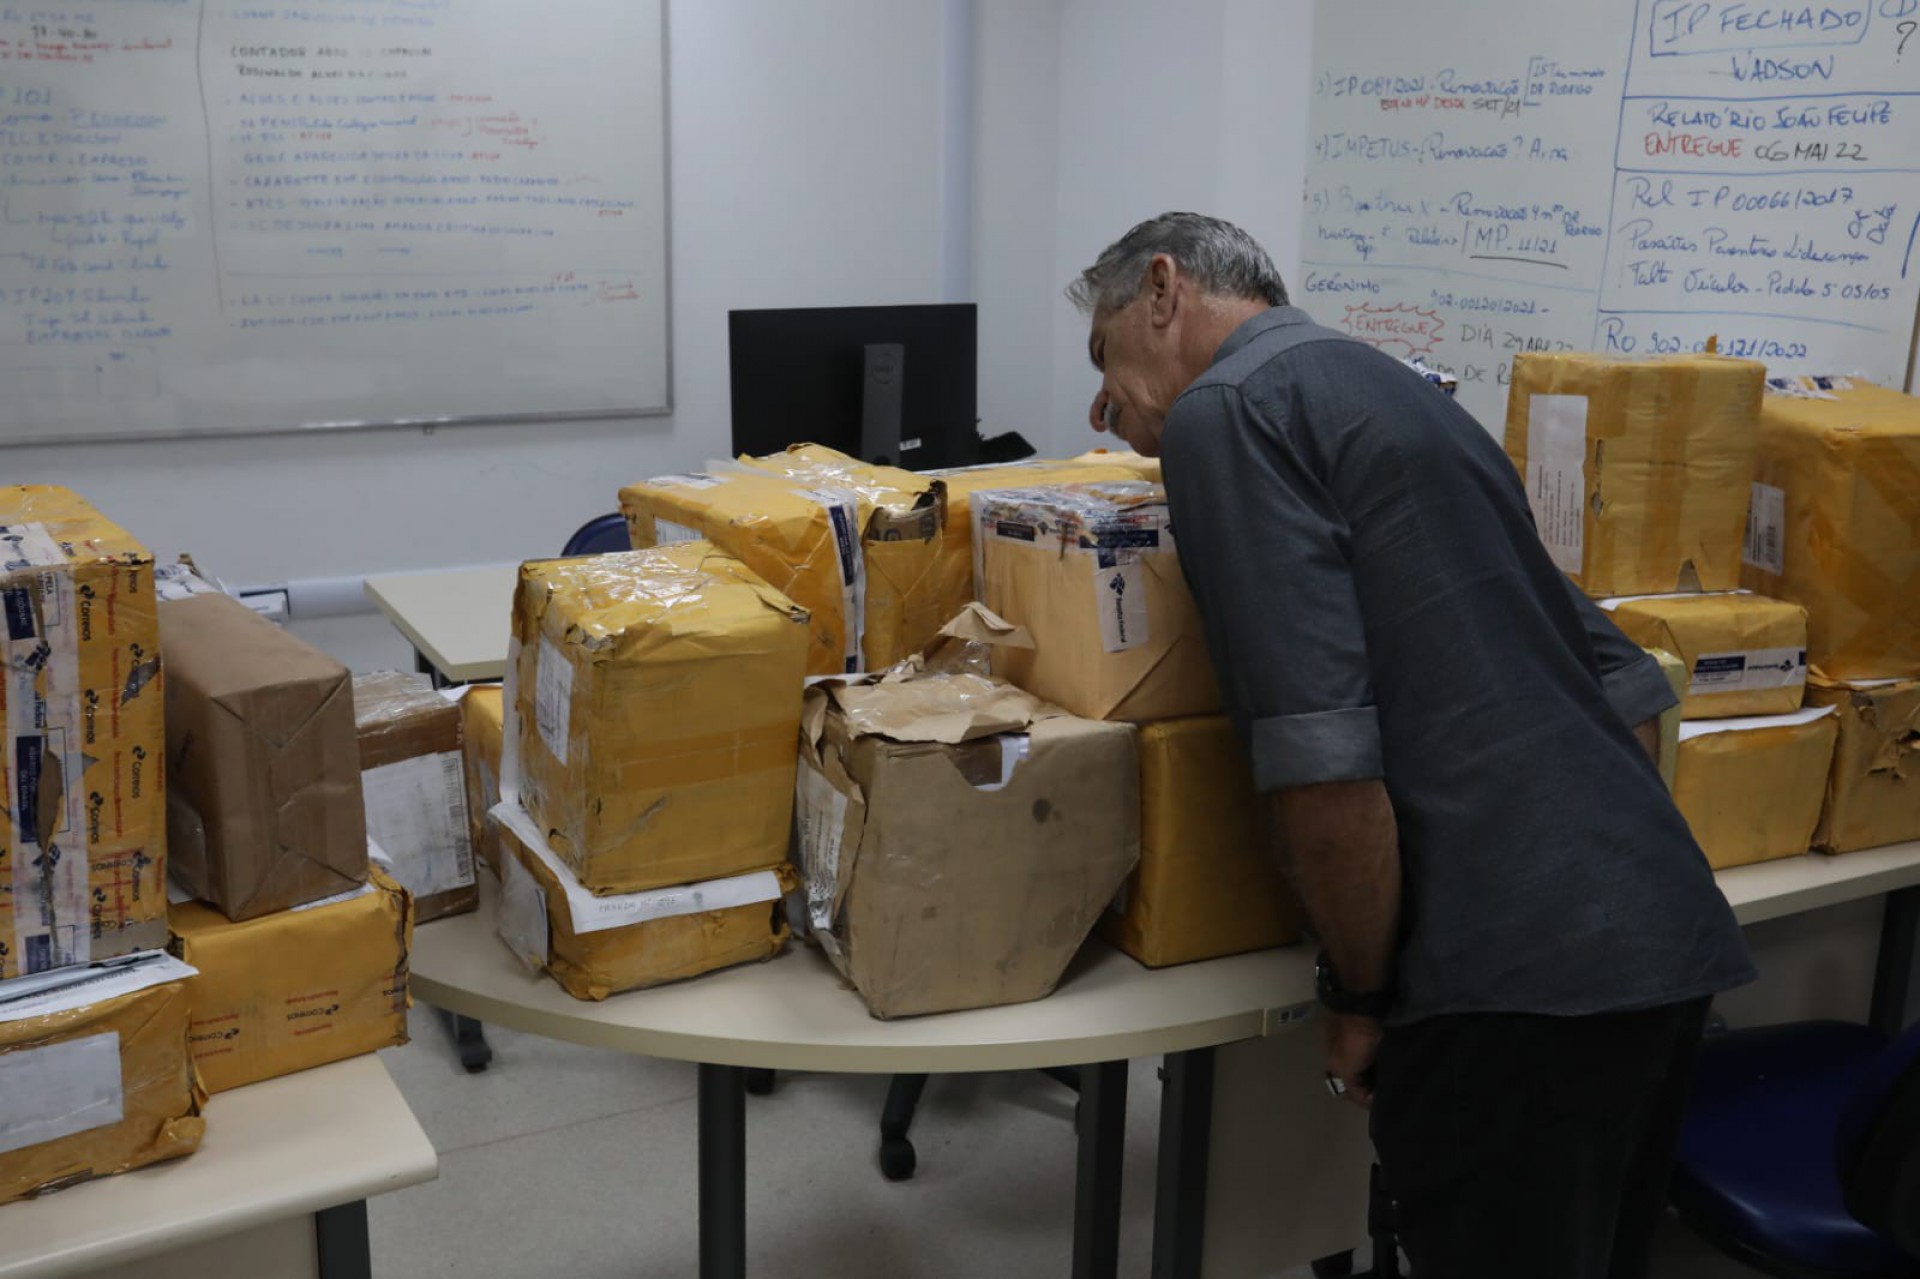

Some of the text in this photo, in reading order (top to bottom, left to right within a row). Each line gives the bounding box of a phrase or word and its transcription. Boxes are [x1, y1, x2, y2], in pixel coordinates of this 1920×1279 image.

[1720, 9, 1862, 34] FECHADO
[1828, 101, 1892, 126] FELIPE
[1645, 132, 1744, 159] ENTREGUE
[1836, 143, 1868, 161] 22
[1355, 315, 1430, 335] ENTREGUE
